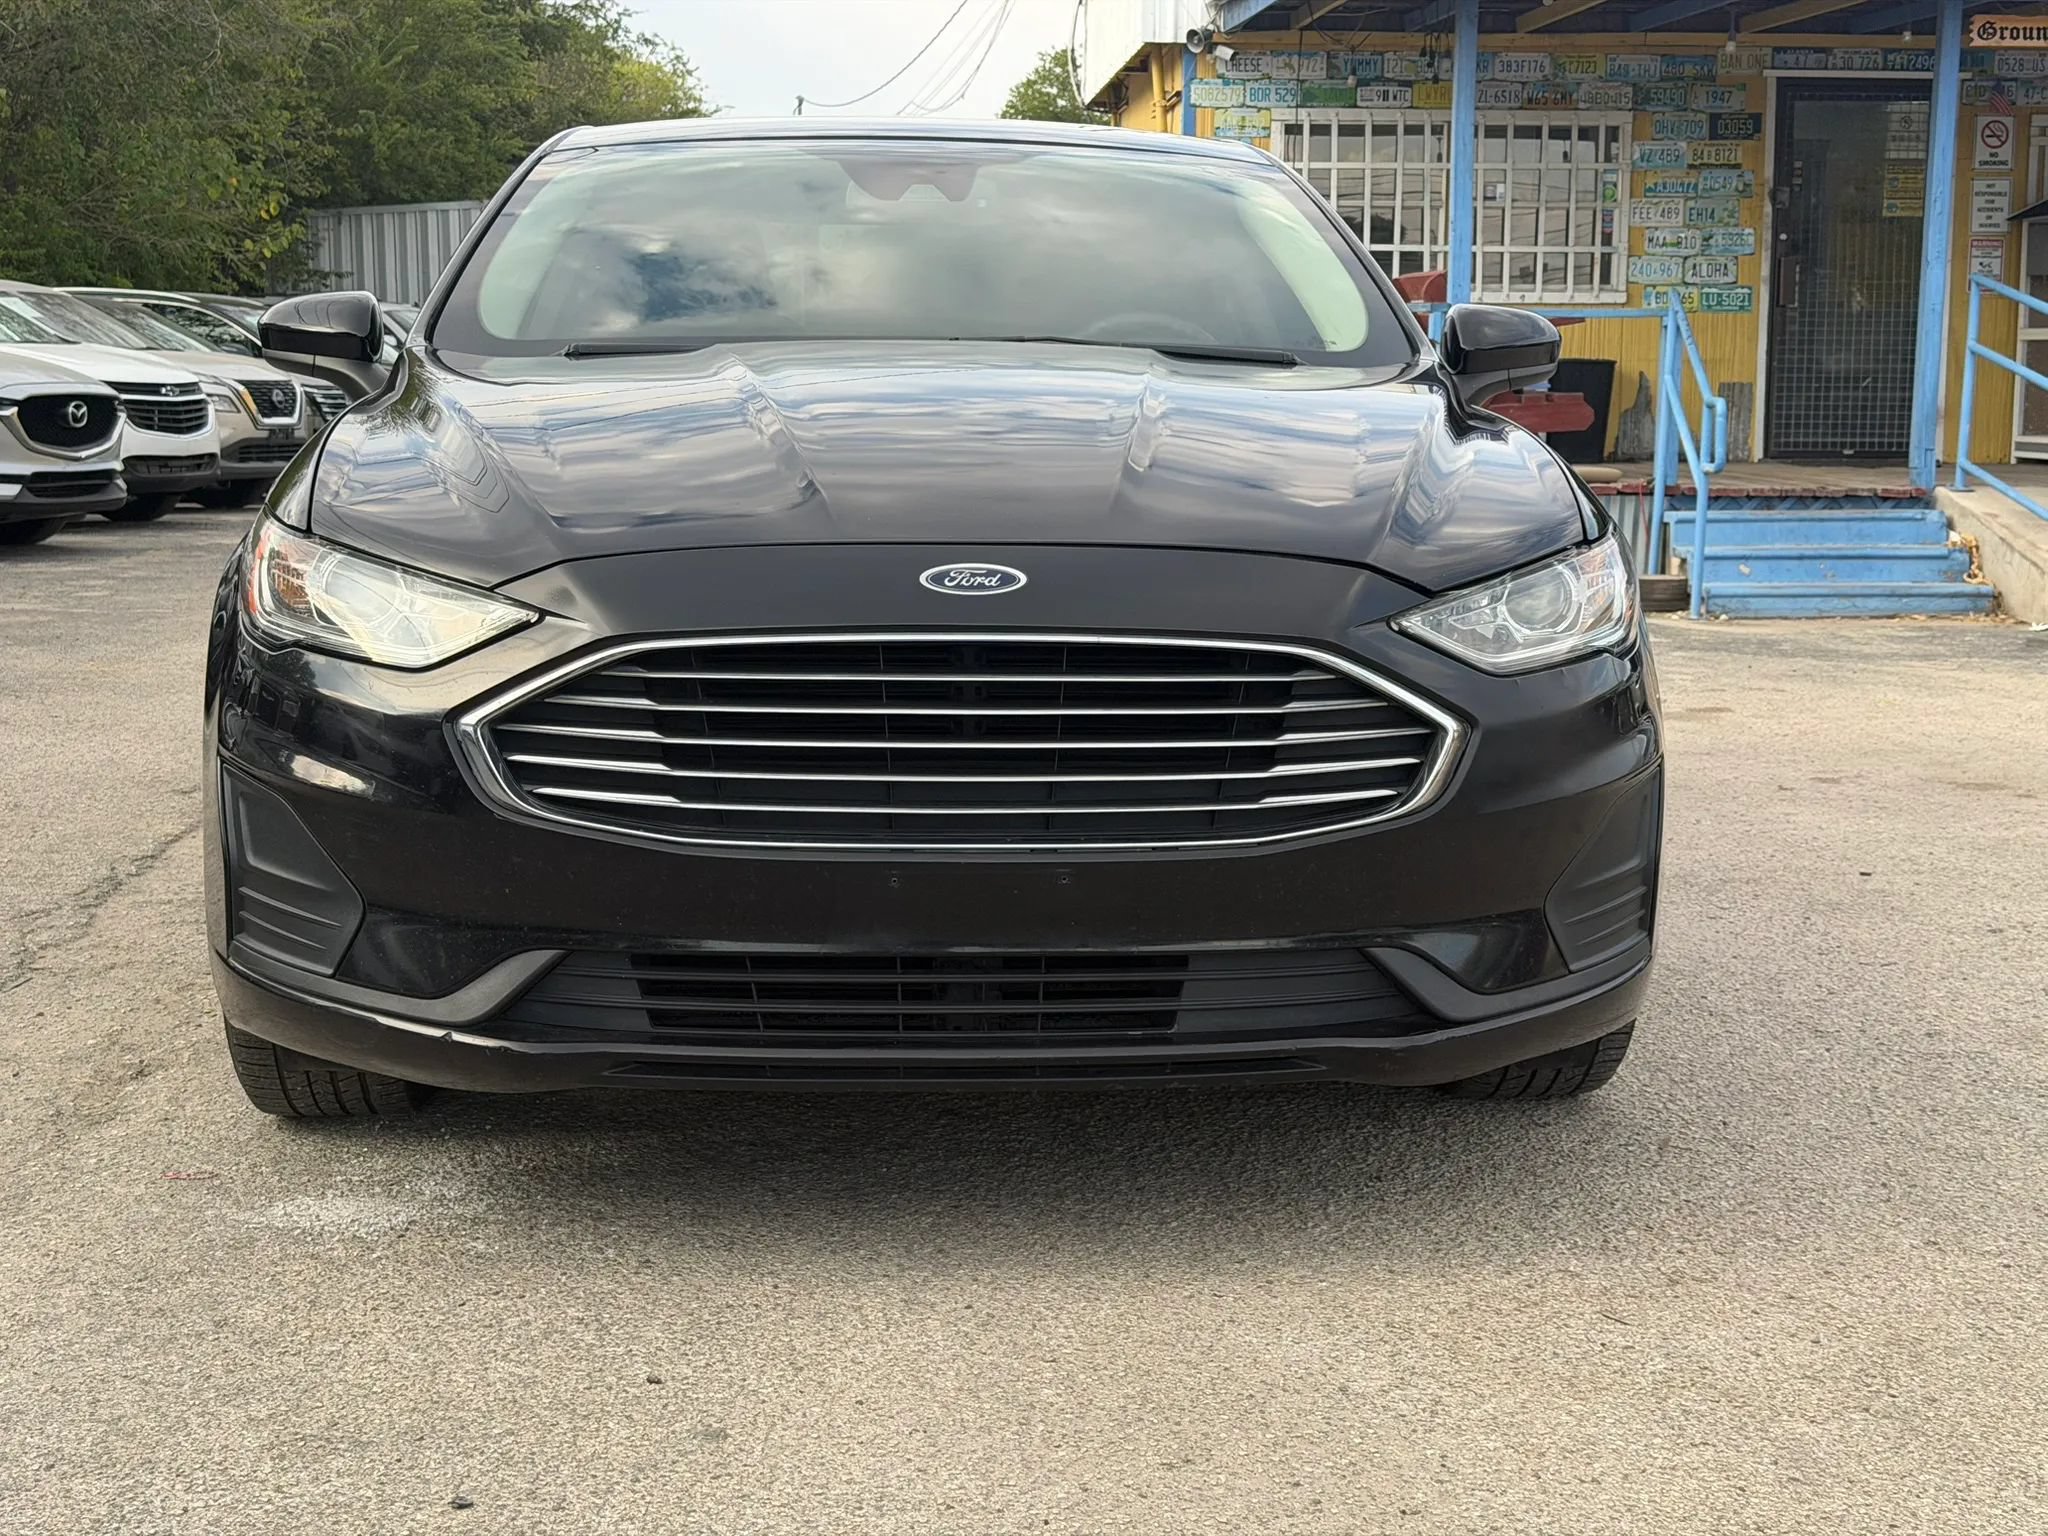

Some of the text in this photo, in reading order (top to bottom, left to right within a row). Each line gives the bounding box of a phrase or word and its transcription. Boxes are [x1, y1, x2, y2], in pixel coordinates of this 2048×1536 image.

[1392, 89, 1409, 102] WTC
[1632, 206, 1652, 220] FEE
[1691, 263, 1729, 278] ALOHA
[943, 568, 1002, 588] Ford
